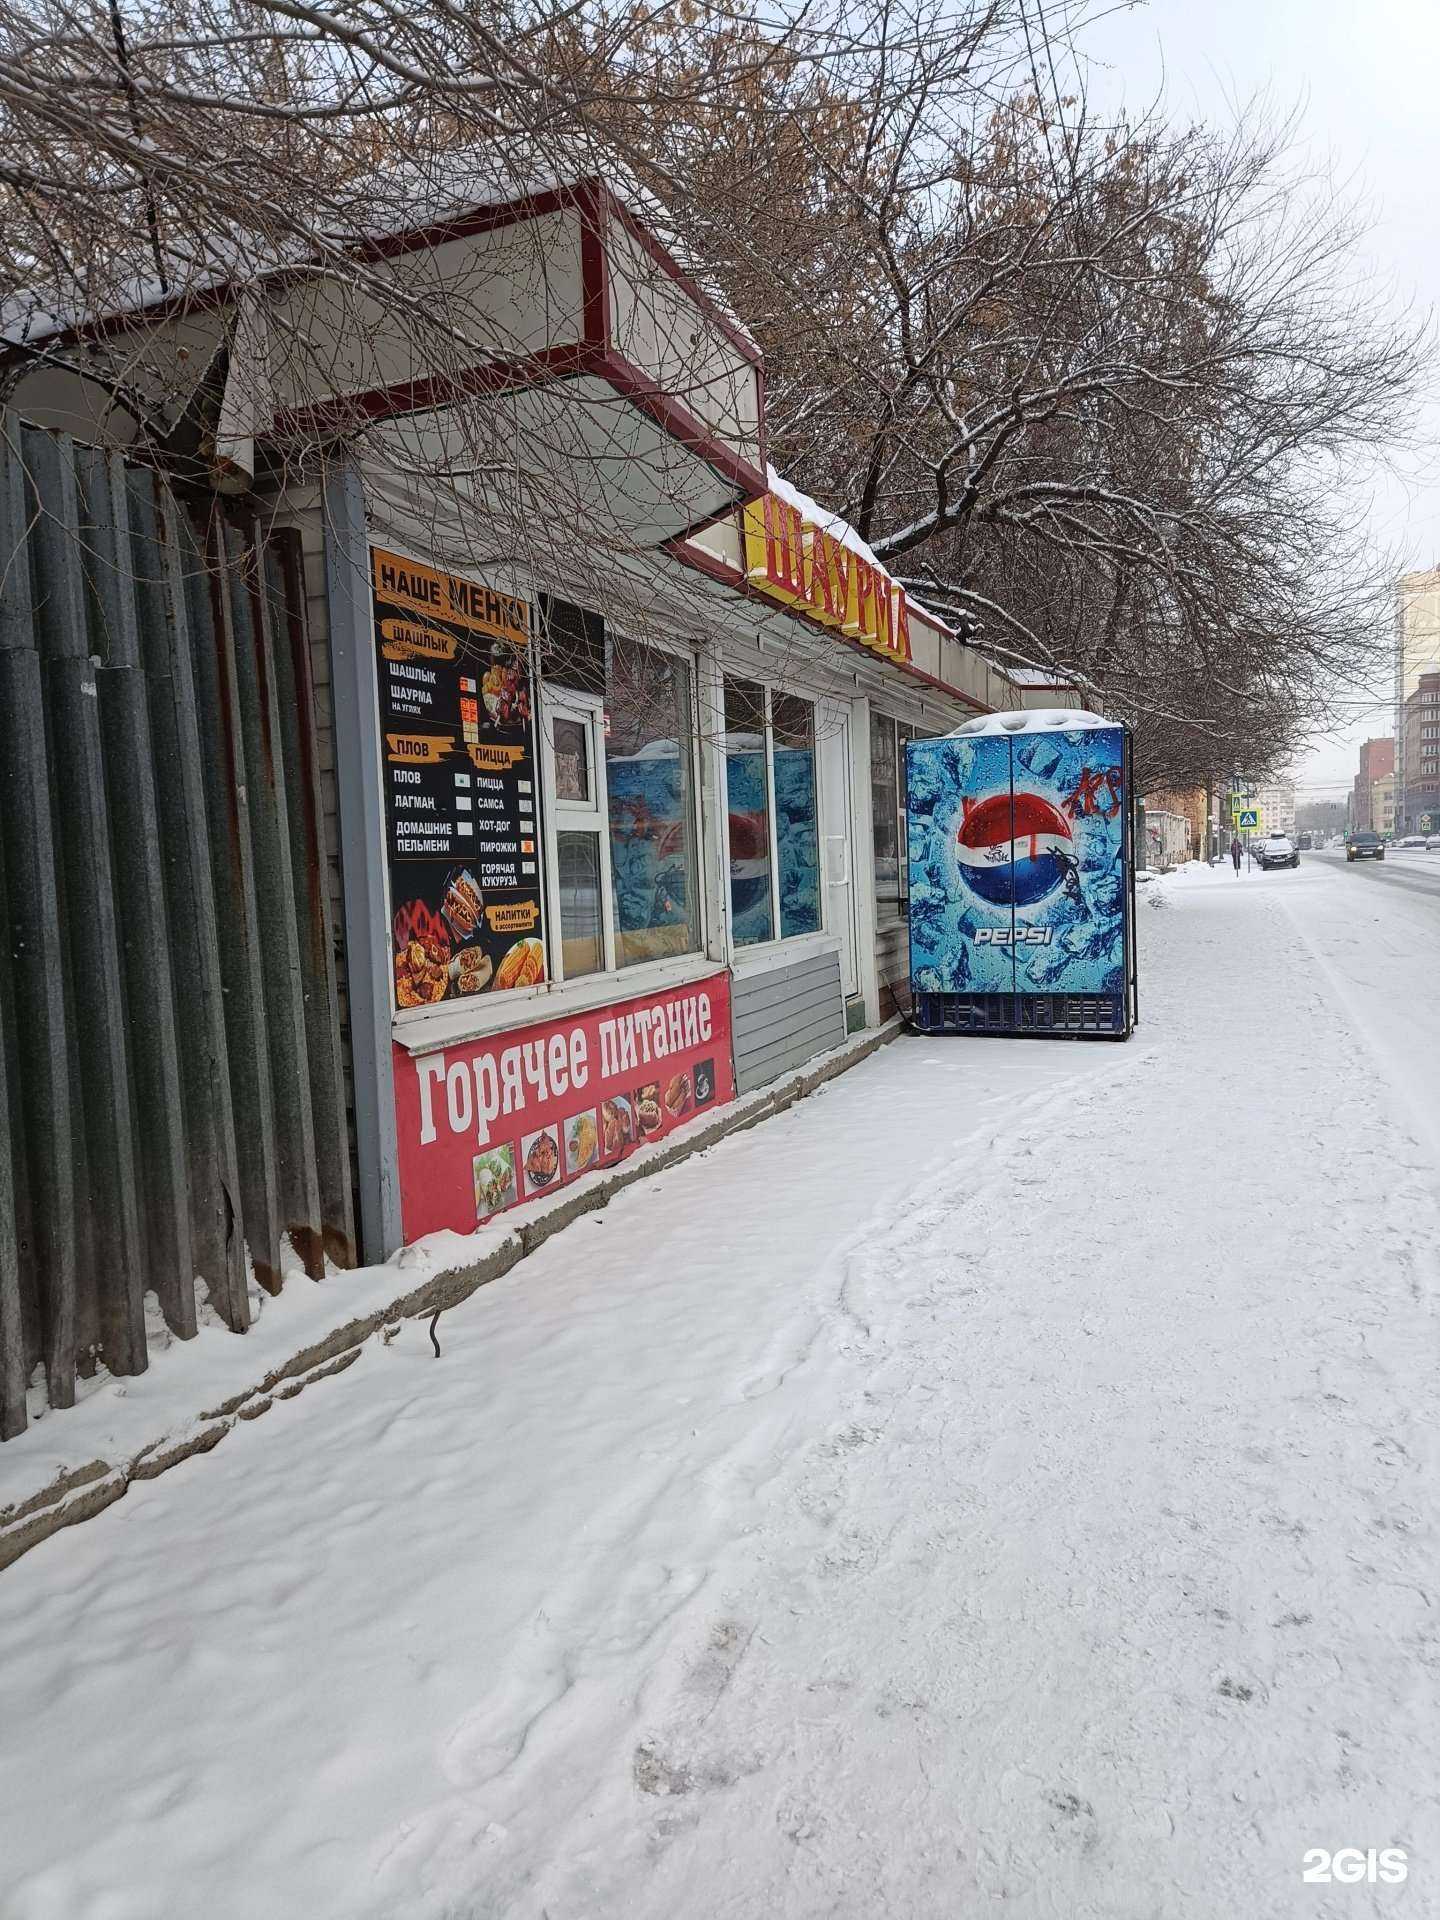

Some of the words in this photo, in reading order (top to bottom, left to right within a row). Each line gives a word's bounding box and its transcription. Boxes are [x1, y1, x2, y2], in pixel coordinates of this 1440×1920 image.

[381, 564, 442, 606] НАШЕ
[449, 579, 524, 632] МЕНЮ
[393, 625, 449, 654] ШАШЛЫК
[389, 662, 437, 685] ШАШЛЫК
[390, 685, 433, 705] ШАУРМА
[396, 739, 429, 756] ПЛОВ
[475, 748, 511, 765] ПИЦЦА
[393, 769, 422, 784] ПЛОВ
[476, 777, 504, 791] ПИЦЦА
[394, 795, 435, 810] ЛАГМАН
[478, 798, 505, 810] САМСА
[396, 821, 452, 835] ДОМАШНИЕ
[479, 819, 511, 833] ХОТ-ДОГ
[397, 839, 450, 852] ПЕЛЬМЕНИ
[480, 841, 517, 853] ПИРОЖКИ
[481, 863, 515, 874] ГОРЯЧАЯ
[482, 876, 518, 887] КУКУРУЗА
[495, 909, 531, 921] НАПИТКИ
[973, 926, 1054, 947] PEPSI
[416, 1028, 589, 1147] Горячее
[598, 992, 712, 1079] питание
